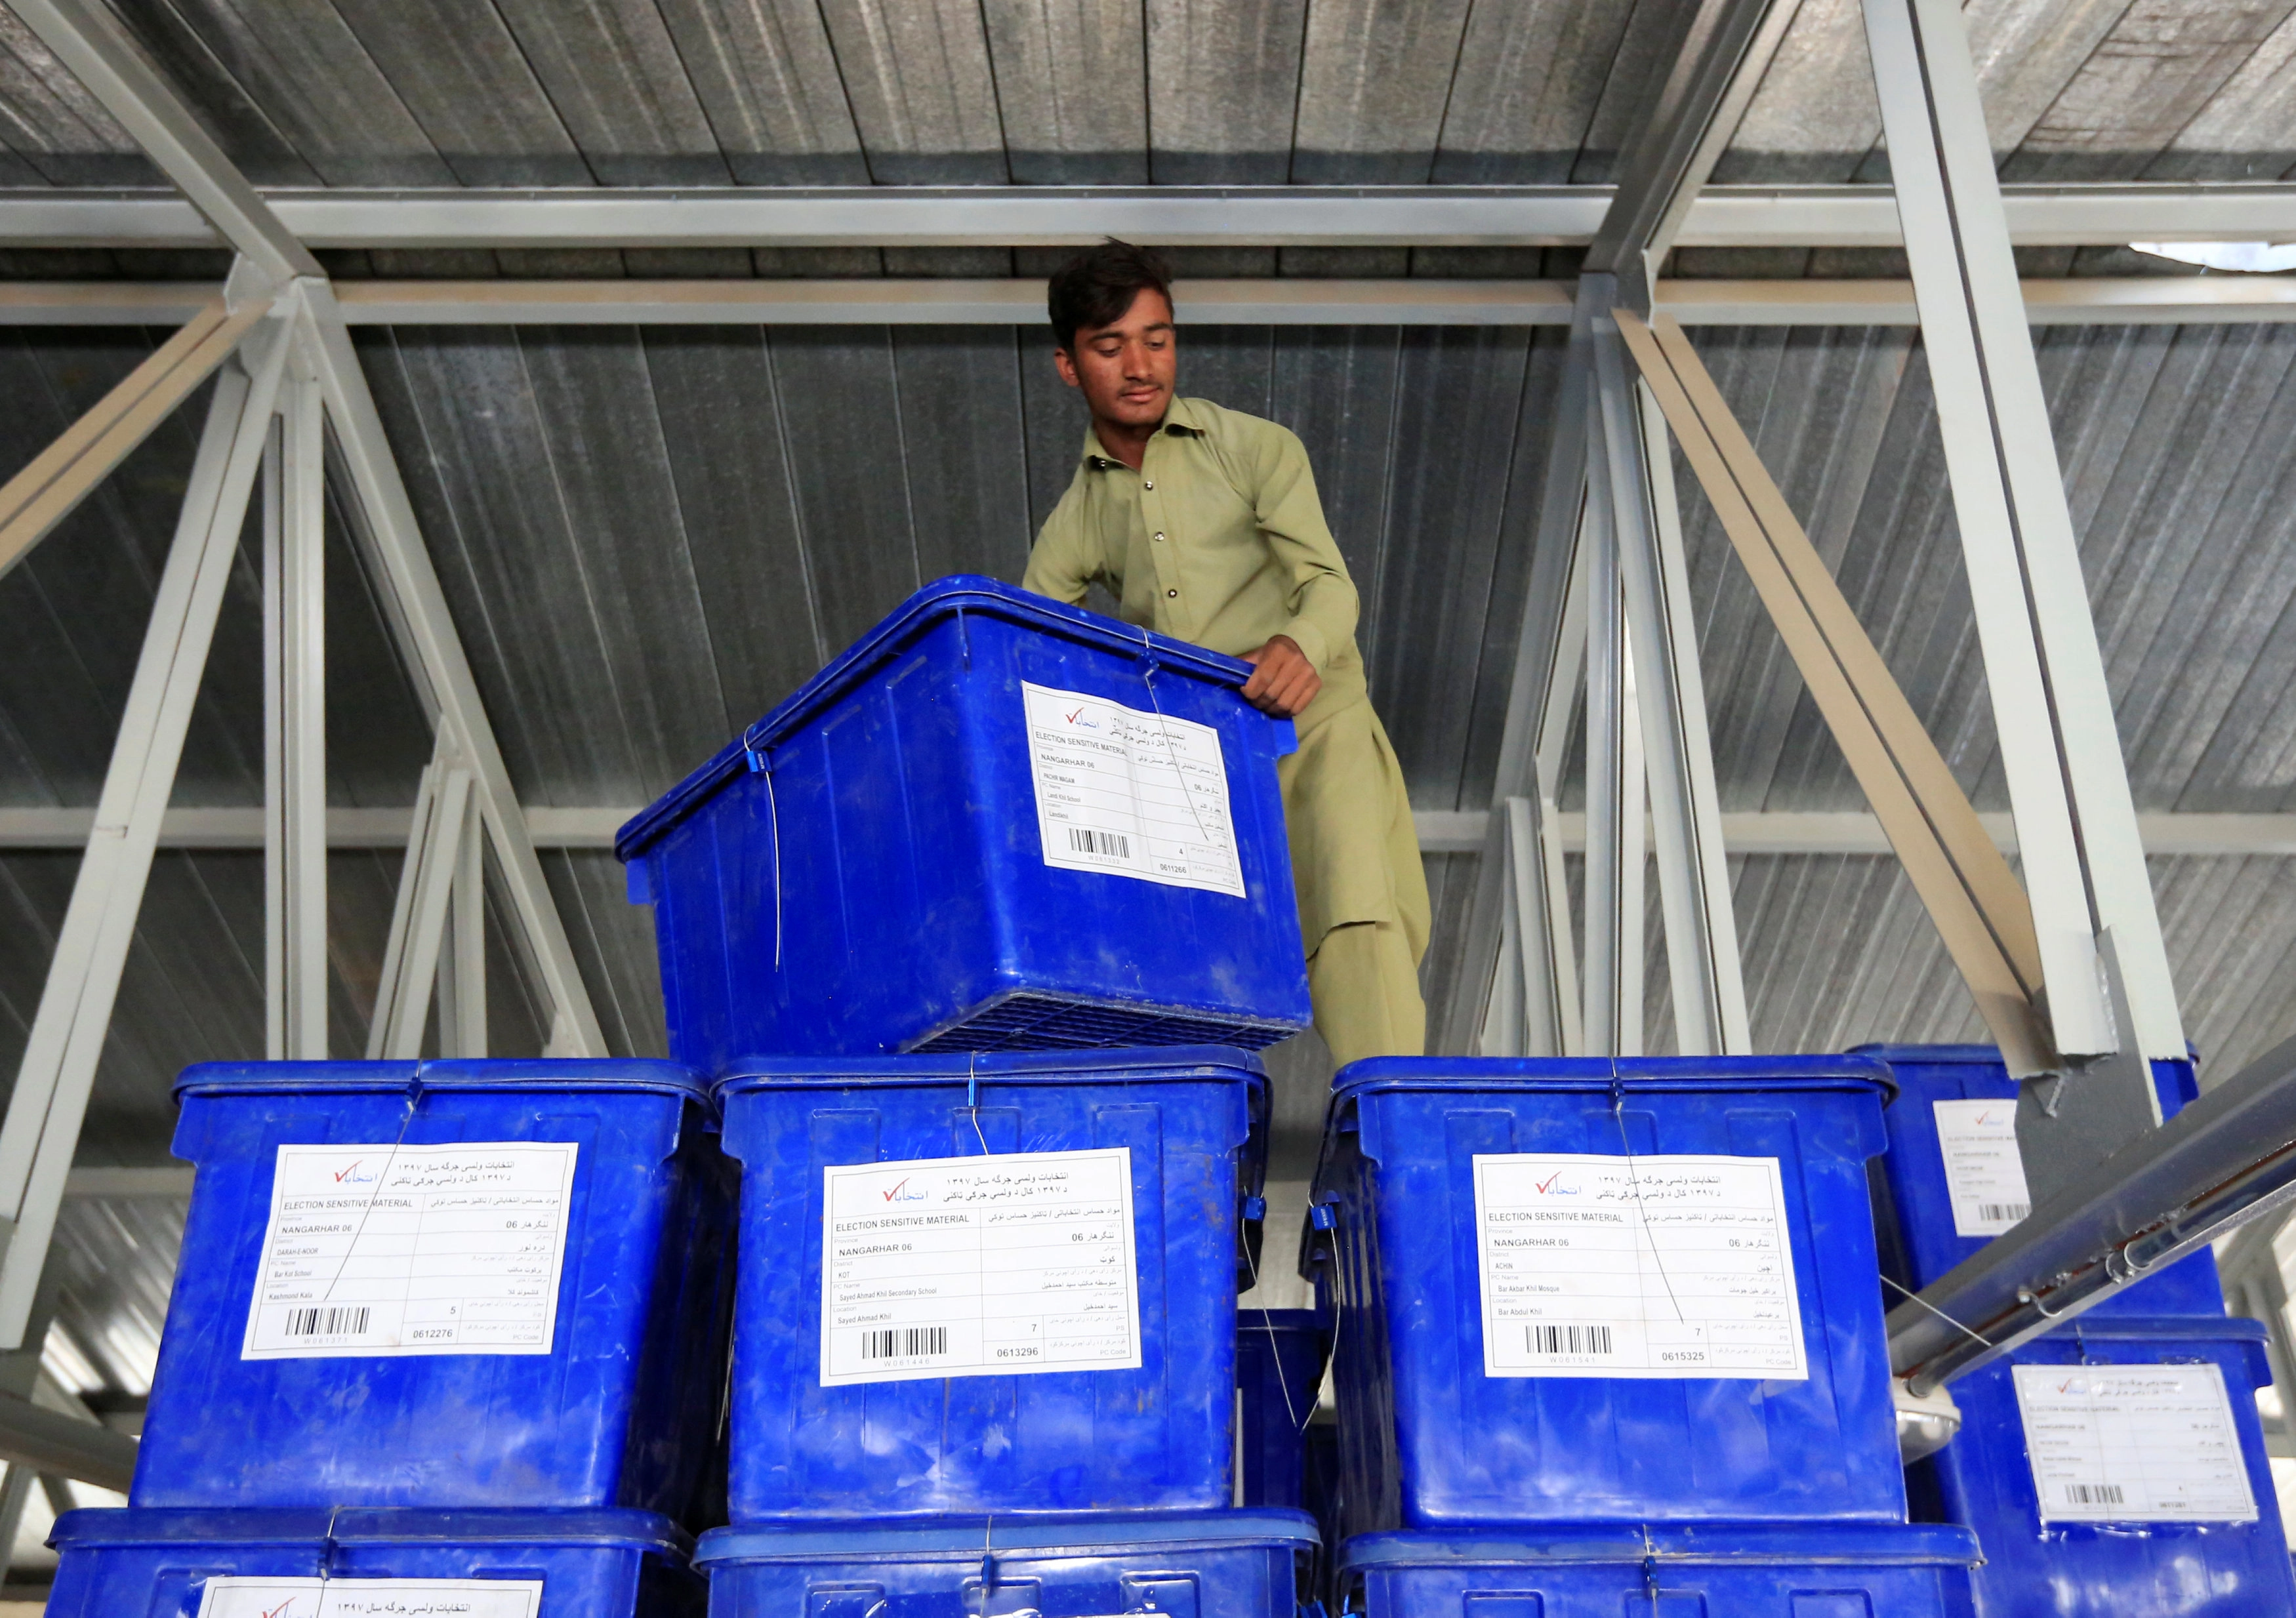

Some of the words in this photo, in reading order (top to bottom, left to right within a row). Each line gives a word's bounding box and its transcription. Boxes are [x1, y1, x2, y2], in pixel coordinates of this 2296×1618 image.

[1035, 731, 1066, 744] ELECTION
[1068, 738, 1100, 750] SENSITIVE
[1101, 744, 1128, 757] MATERIAL
[1041, 754, 1085, 767] NANGARHAR
[1160, 863, 1187, 874] 0611266
[1038, 1172, 1069, 1181] انتخابات
[284, 1201, 324, 1210] ELECTION
[326, 1200, 369, 1209] SENSITIVE
[371, 1199, 413, 1208] MATERIAL
[1488, 1212, 1532, 1222] ELECTION
[1534, 1212, 1579, 1222] SENSITIVE
[1581, 1213, 1624, 1223] MATERIAL
[836, 1220, 878, 1232] ELECTION
[880, 1217, 924, 1228] SENSITIVE
[926, 1215, 970, 1225] MATERIAL
[281, 1224, 339, 1234] NANGARHAR
[1072, 1232, 1084, 1242] 06
[1494, 1238, 1555, 1247] NANGARHAR
[1558, 1238, 1569, 1247] 06
[1729, 1238, 1740, 1247] 06
[277, 1247, 319, 1257] DARAH-E-NOOR
[839, 1244, 899, 1257] NANGARHAR
[901, 1243, 912, 1251] 06
[1538, 1284, 1560, 1293] Mosque
[839, 1293, 856, 1302] Sayed
[888, 1289, 916, 1298] Secondary
[917, 1287, 937, 1295] School
[450, 1306, 457, 1314] 5
[838, 1317, 856, 1325] Sayed
[857, 1314, 878, 1323] Ahmad
[879, 1312, 892, 1321] Khil
[1031, 1324, 1038, 1332] 7
[413, 1329, 453, 1339] 0612276
[996, 1347, 1038, 1358] 0613296
[1662, 1352, 1705, 1362] 0615325
[436, 1603, 471, 1613] انتخابات
